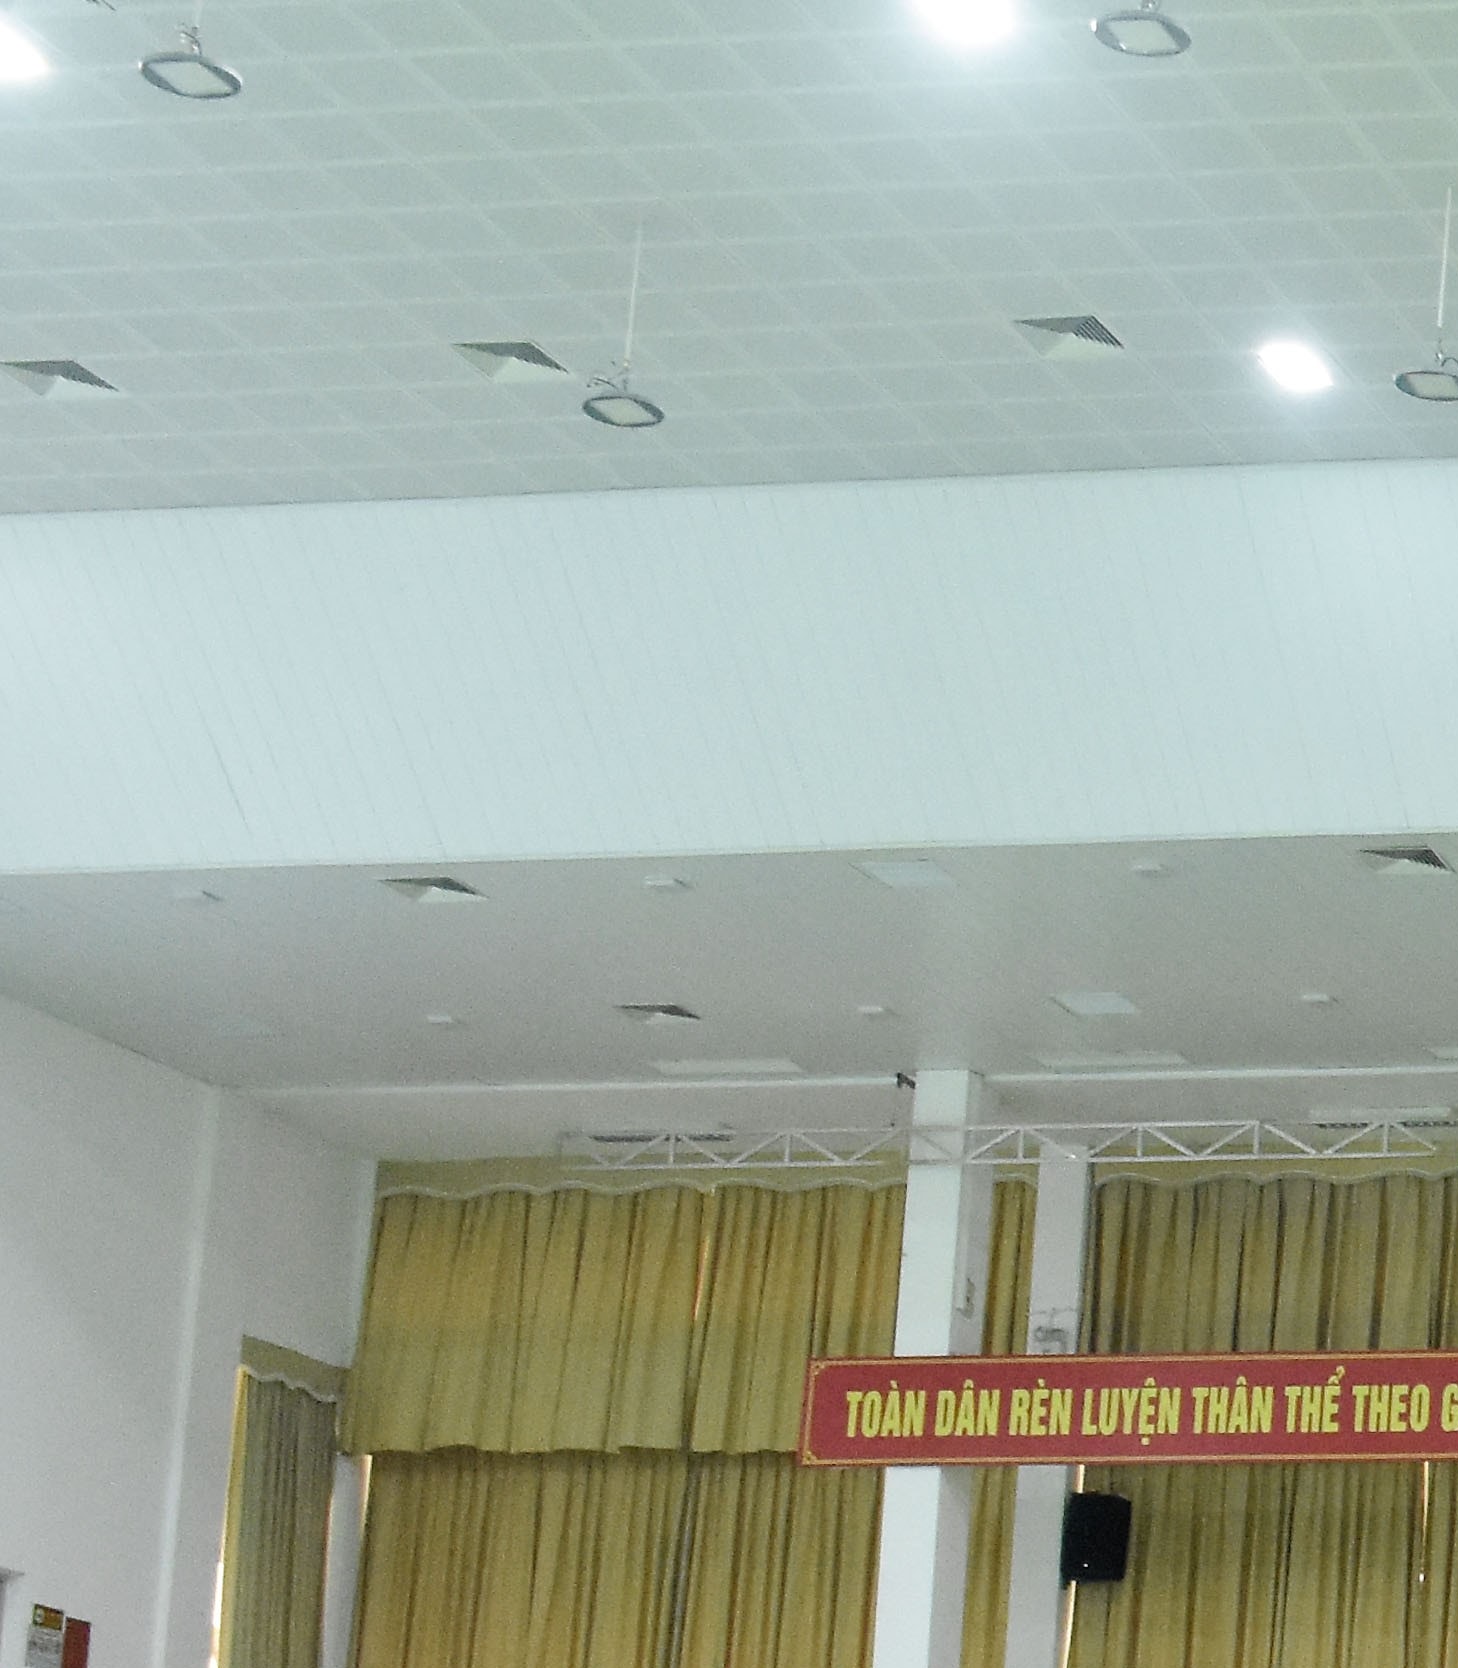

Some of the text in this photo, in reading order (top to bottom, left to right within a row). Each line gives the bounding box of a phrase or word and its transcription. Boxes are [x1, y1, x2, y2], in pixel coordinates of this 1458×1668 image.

[847, 1380, 926, 1437] TOÀN
[935, 1379, 1000, 1436] DÂN
[1009, 1379, 1073, 1436] RÈN
[1082, 1378, 1181, 1445] LUYỆN
[1192, 1376, 1274, 1434] THÂN
[1285, 1366, 1345, 1433] THỂ
[1352, 1384, 1430, 1432] THEO
